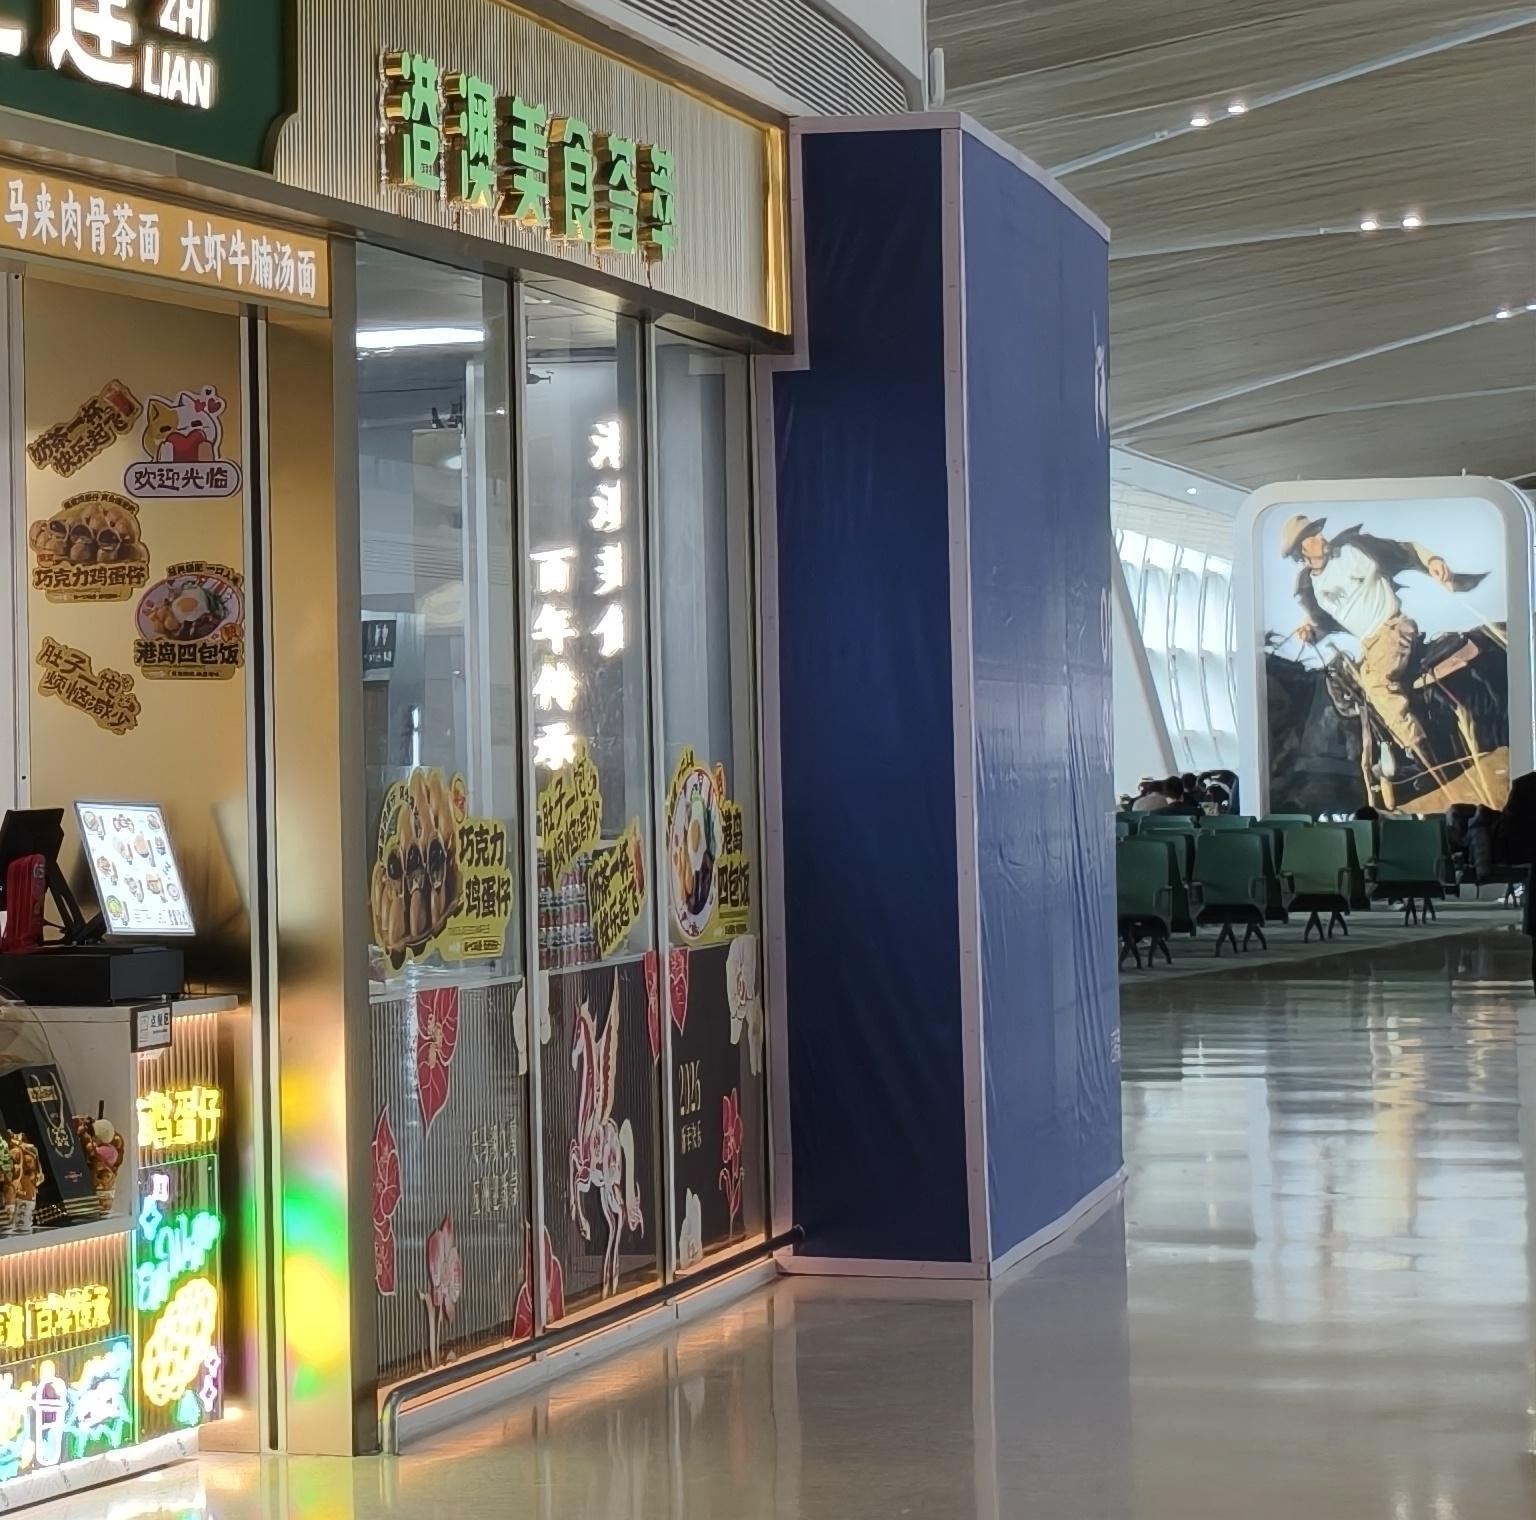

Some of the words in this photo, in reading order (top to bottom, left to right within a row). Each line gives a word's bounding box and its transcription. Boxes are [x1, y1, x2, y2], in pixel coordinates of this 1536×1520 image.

[141, 48, 211, 112] LIAN
[5, 178, 161, 266] 马来肉骨茶面
[180, 218, 317, 300] 大虾牛腩汤面
[133, 466, 229, 491] 欢迎光临
[34, 565, 146, 589] 巧克力鸡蛋仔
[458, 823, 506, 868] 巧克力
[465, 875, 512, 919] 鸡蛋仔
